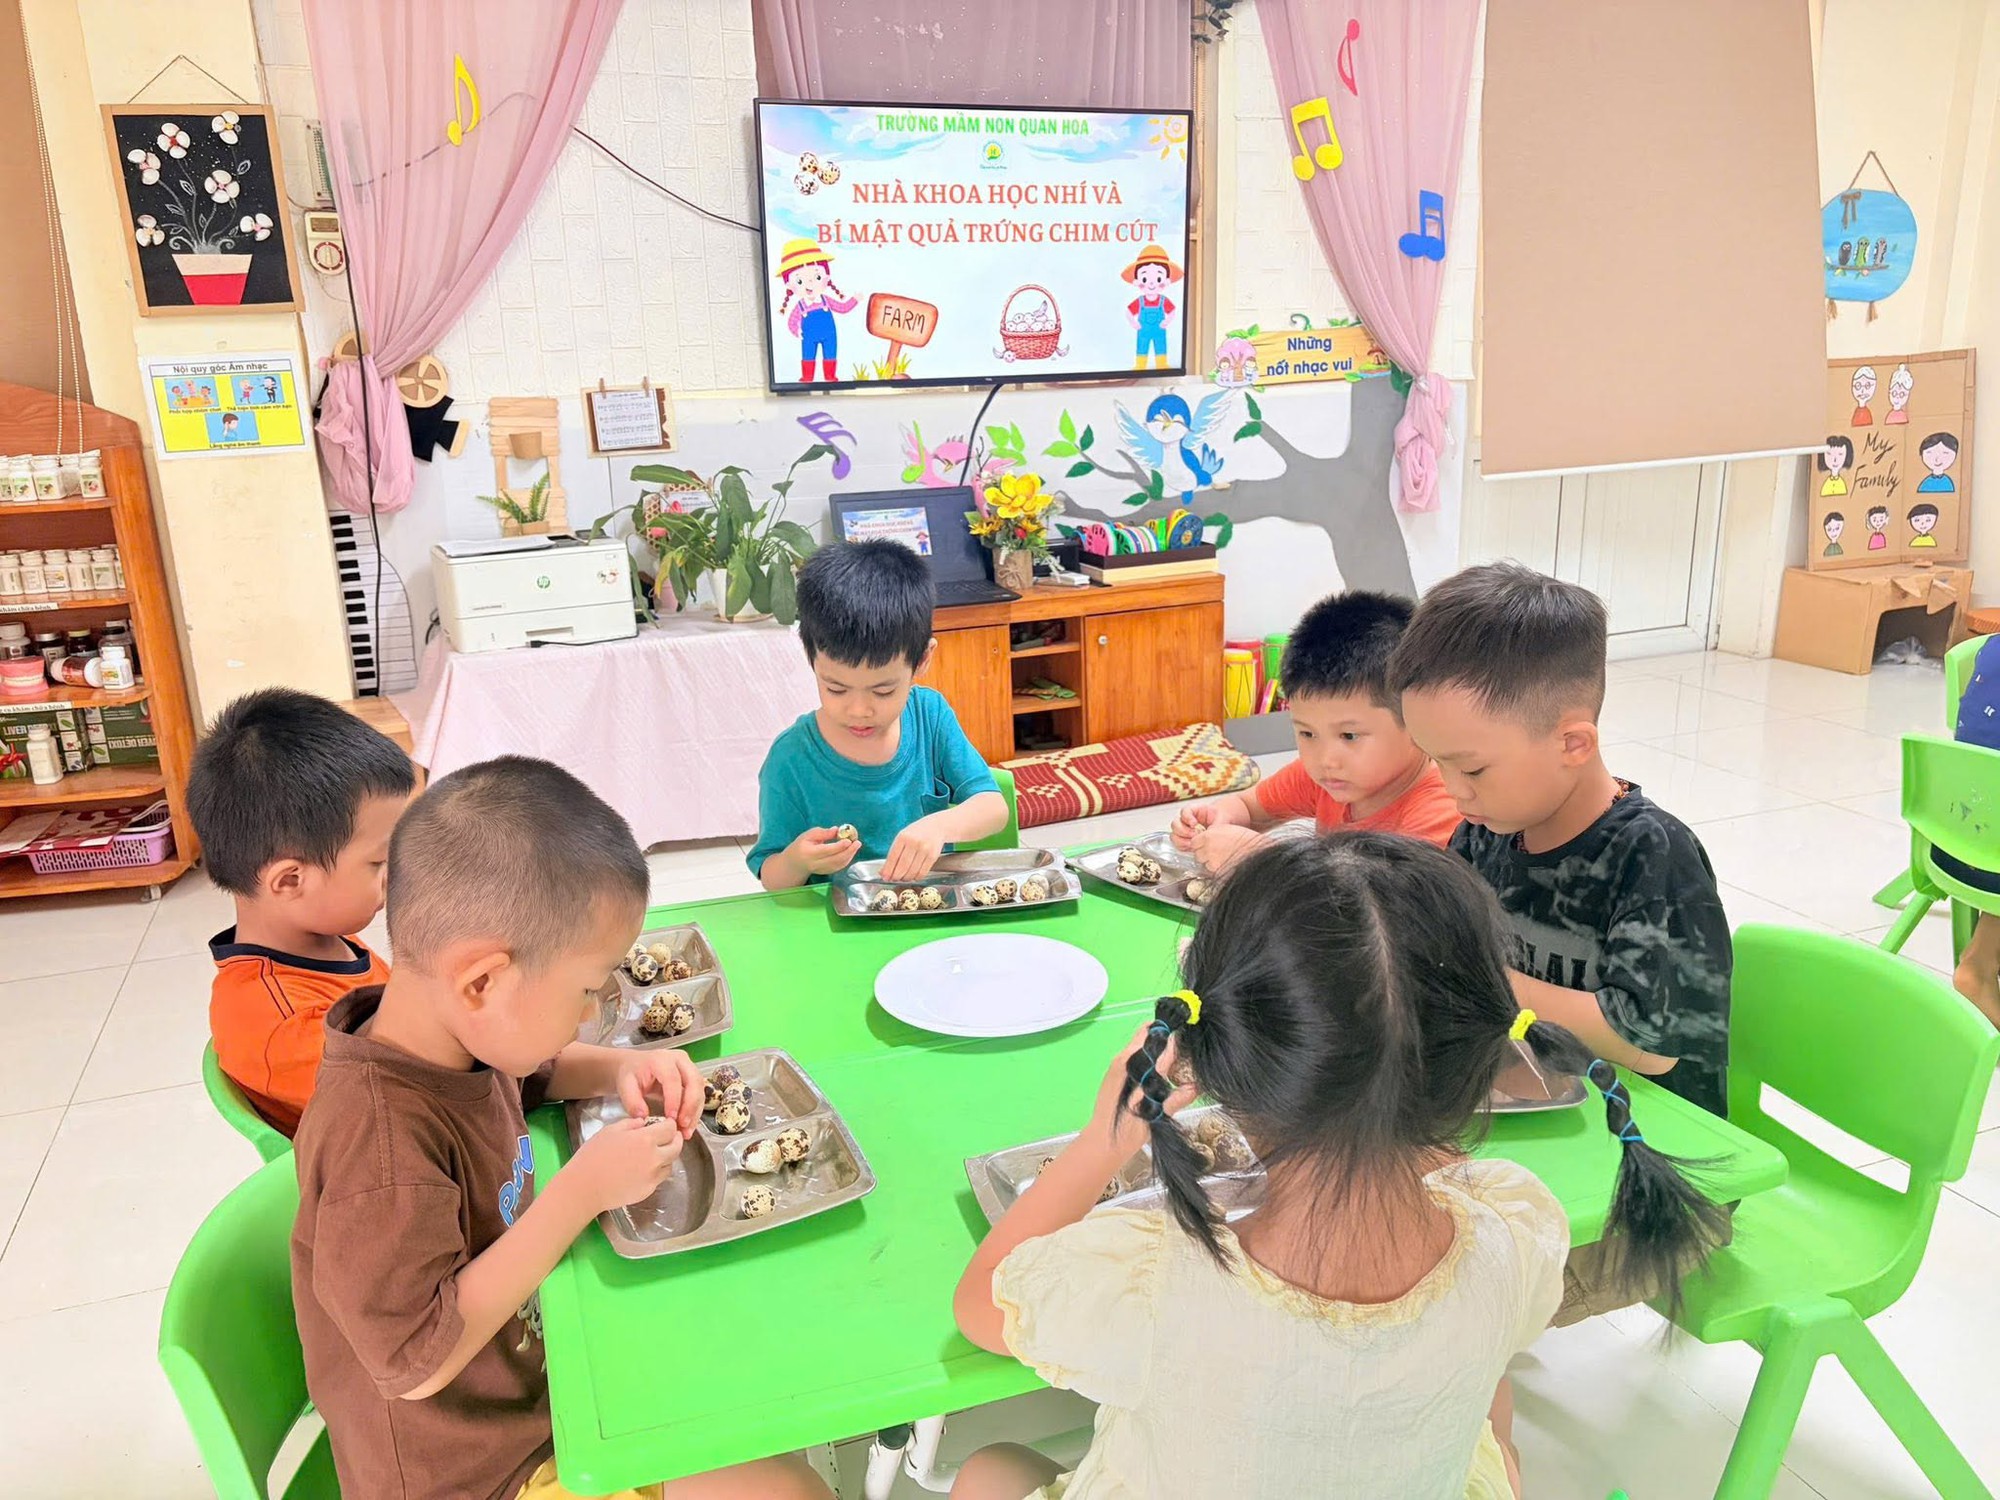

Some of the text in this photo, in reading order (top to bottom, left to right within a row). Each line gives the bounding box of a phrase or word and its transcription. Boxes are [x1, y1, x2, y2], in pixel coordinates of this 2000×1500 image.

[876, 110, 1089, 136] TRƯỜNG MẦM NON QUAN HOA
[852, 178, 1122, 209] NHÀ KHOA HỌC NHÍ VÀ
[817, 216, 1158, 248] BÍ MẬT QUẢ TRỨNG CHIM CÚT
[882, 305, 926, 335] FARM
[1287, 336, 1332, 352] Những
[173, 362, 268, 374] Nội quy góc Âm nhạc
[1266, 357, 1353, 376] nốt nhạc vui
[1863, 431, 1897, 465] My
[1850, 461, 1902, 498] Family
[3, 724, 28, 736] LIVER
